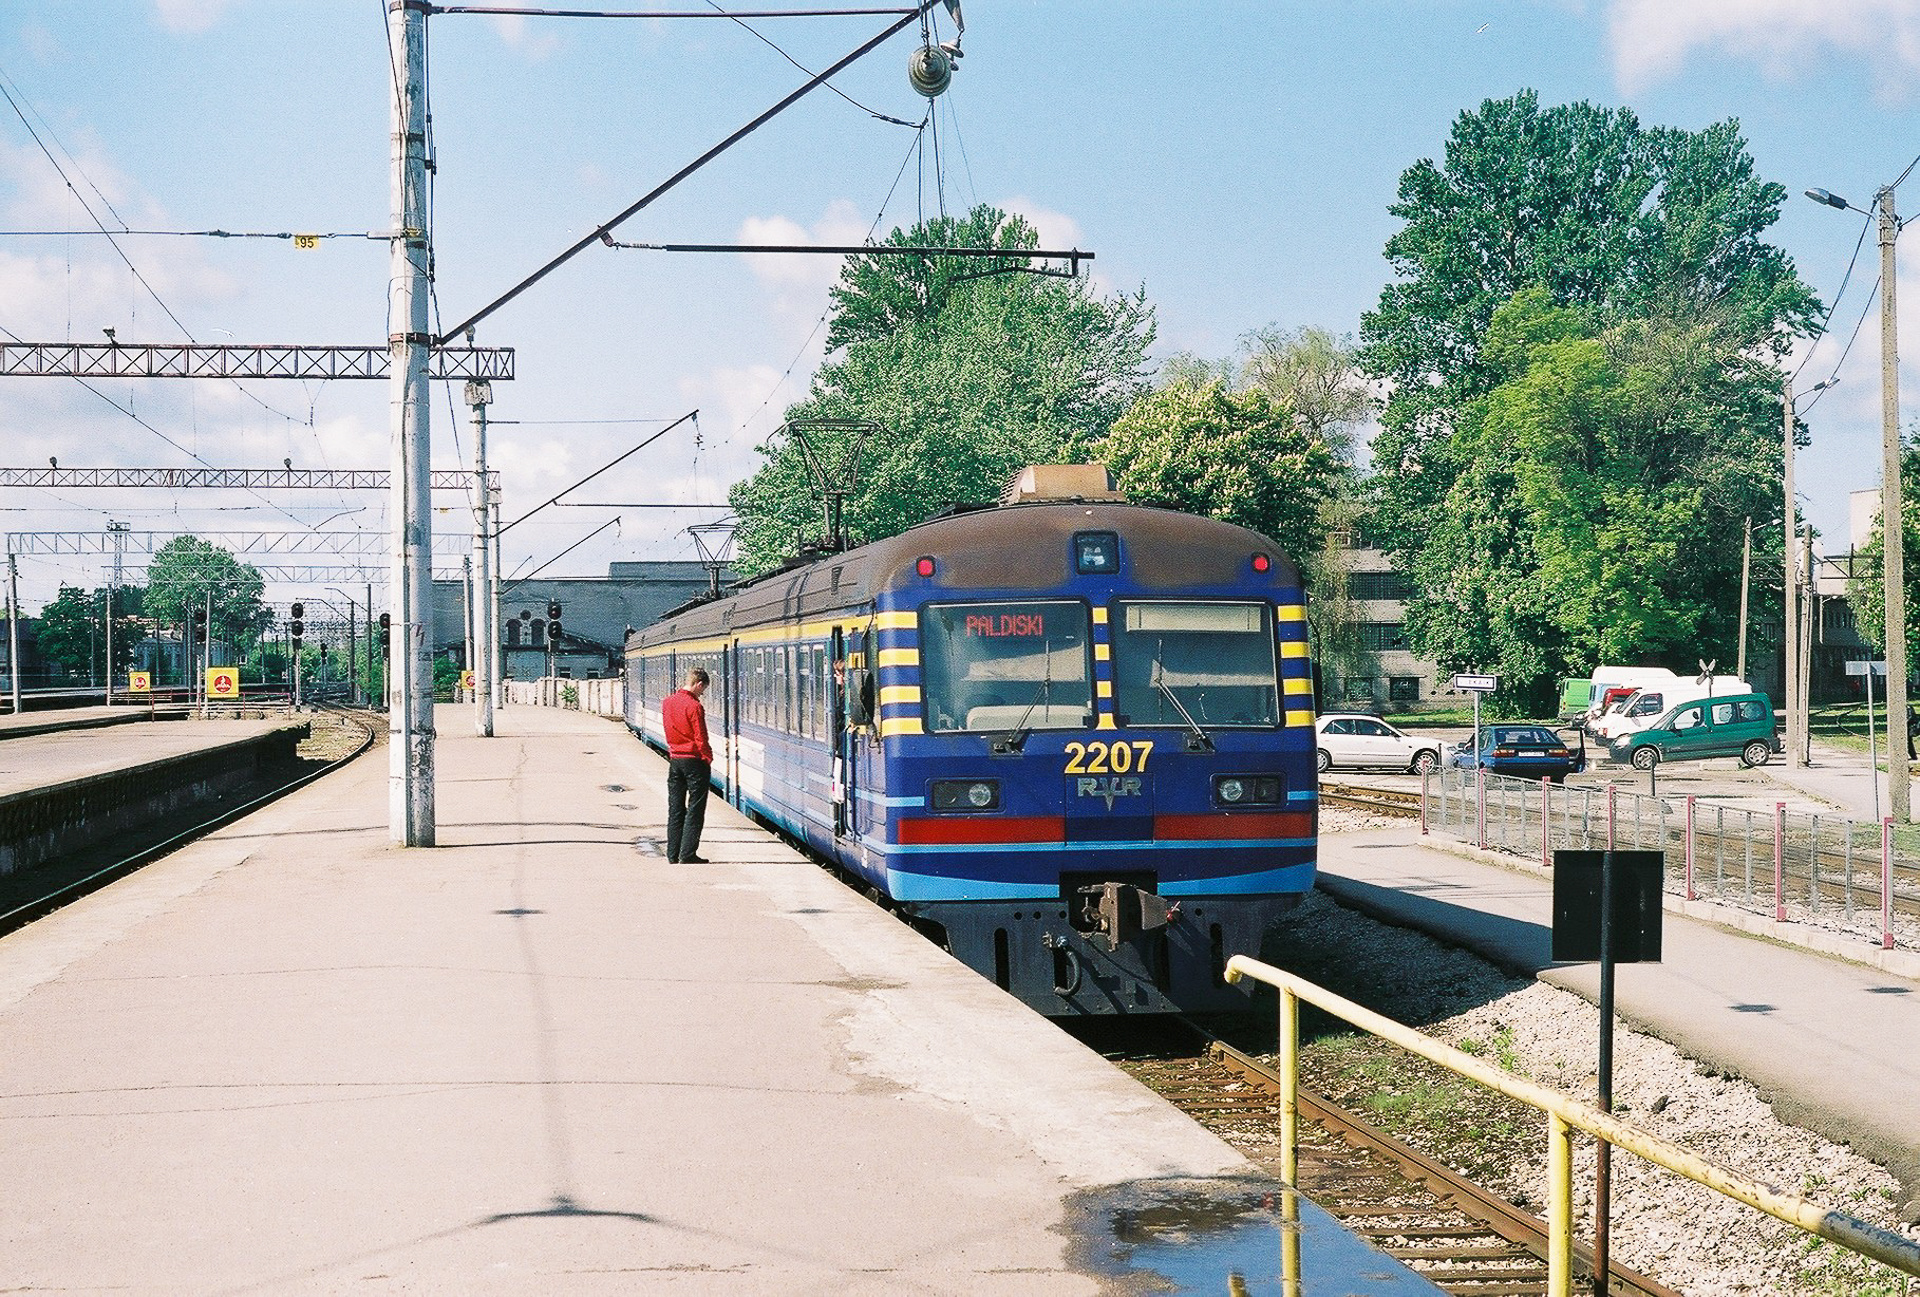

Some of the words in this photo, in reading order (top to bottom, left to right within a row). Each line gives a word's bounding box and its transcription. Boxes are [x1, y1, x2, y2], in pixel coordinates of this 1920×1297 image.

[966, 614, 1043, 637] PALDISKI
[1064, 740, 1154, 774] 2207
[1077, 777, 1142, 811] RVR
